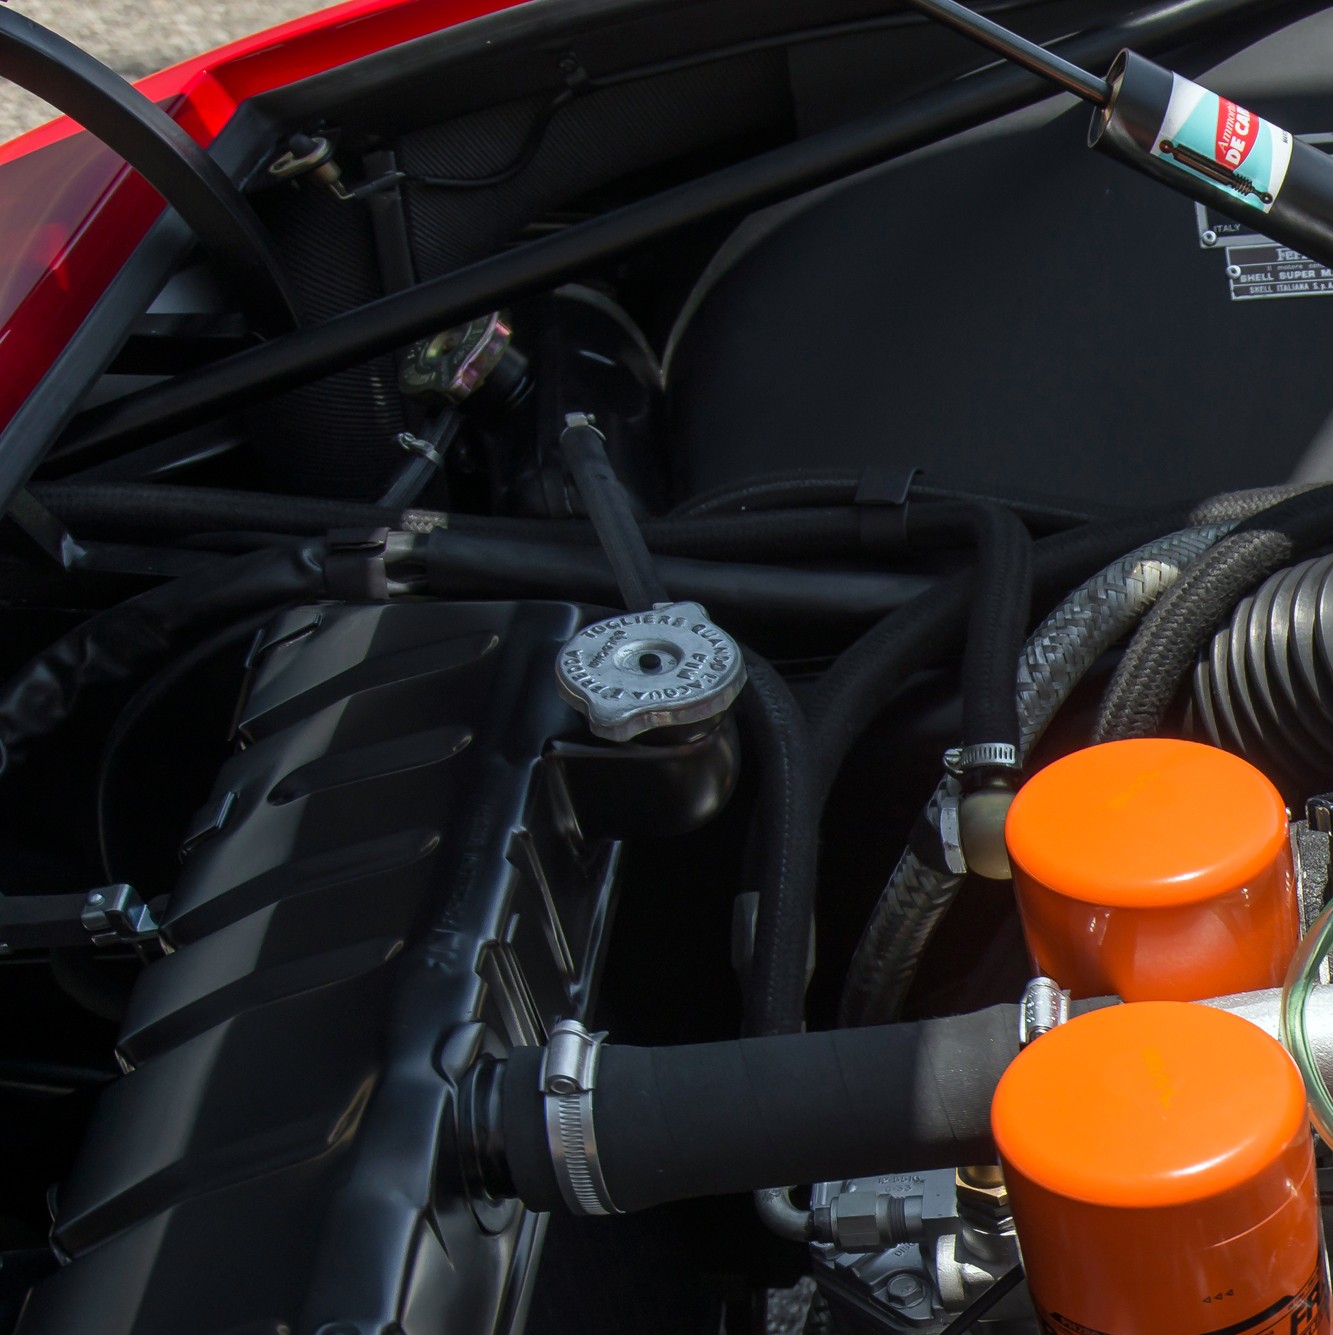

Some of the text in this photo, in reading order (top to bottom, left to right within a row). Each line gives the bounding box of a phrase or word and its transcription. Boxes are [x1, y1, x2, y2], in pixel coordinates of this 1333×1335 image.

[1225, 137, 1246, 166] DE
[1213, 223, 1241, 233] ITALY
[1240, 273, 1275, 283] SHELL
[1279, 270, 1317, 280] SUPER
[1250, 284, 1275, 294] SHELL
[1277, 283, 1310, 292] ITALIANA
[580, 615, 687, 639] TOGLIERE
